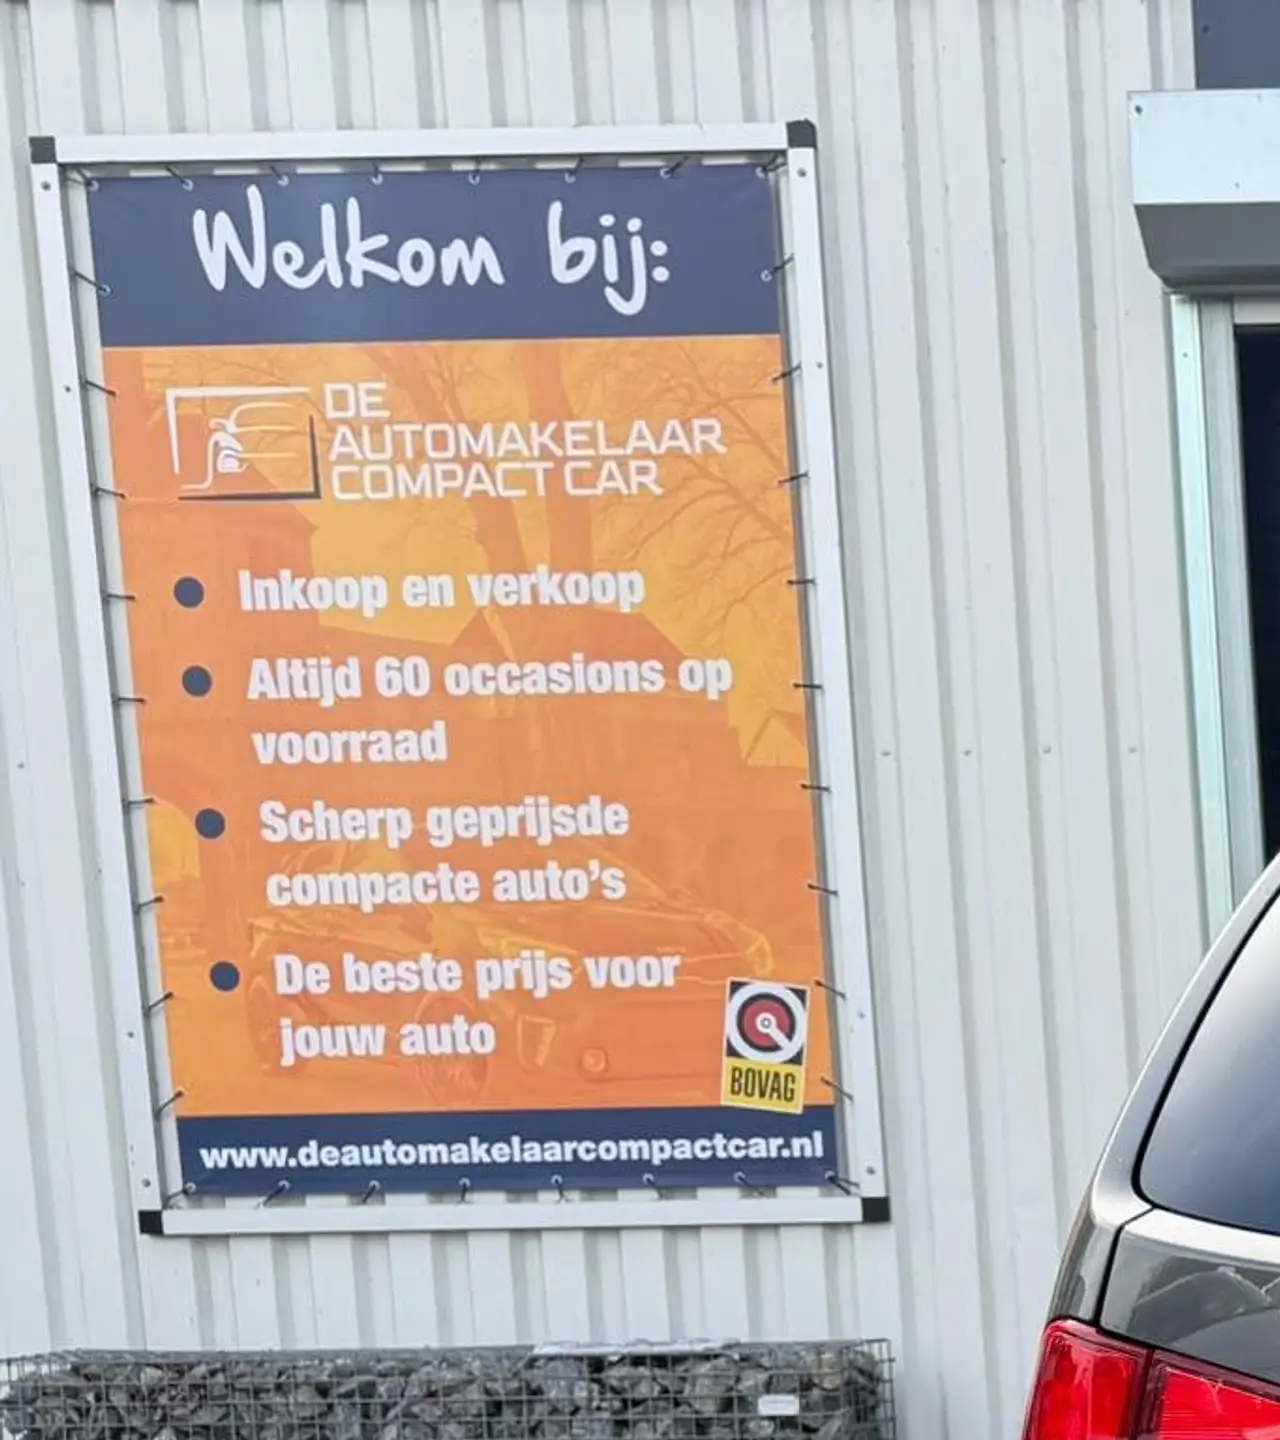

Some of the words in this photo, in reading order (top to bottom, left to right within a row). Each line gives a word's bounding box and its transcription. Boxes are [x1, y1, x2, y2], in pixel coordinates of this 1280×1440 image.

[193, 184, 504, 291] Welkom
[547, 200, 669, 315] bij:
[325, 382, 390, 420] DE
[329, 417, 727, 466] AUTOMAKELAAR
[330, 460, 549, 502] COMPACT
[564, 458, 664, 497] CAR
[239, 570, 391, 617] Inkoop
[403, 574, 456, 609] en
[467, 563, 645, 611] verkoop
[248, 655, 361, 708] Altijd
[375, 655, 430, 697] 60
[444, 651, 664, 696] occasions
[678, 656, 733, 701] op
[251, 719, 448, 766] voorraad
[259, 798, 413, 850] Scherp
[427, 795, 629, 848] geprijsde
[266, 862, 479, 915] compacte
[493, 859, 626, 903] auto's
[274, 953, 330, 997] De
[344, 949, 459, 994] beste
[477, 951, 573, 1000] prijs
[584, 953, 681, 990] voor
[279, 1015, 386, 1068] jouw
[399, 1013, 496, 1057] auto
[729, 1063, 797, 1103] BOVAG
[200, 1130, 824, 1172] www.deautomakelaarcompactcar.nl
